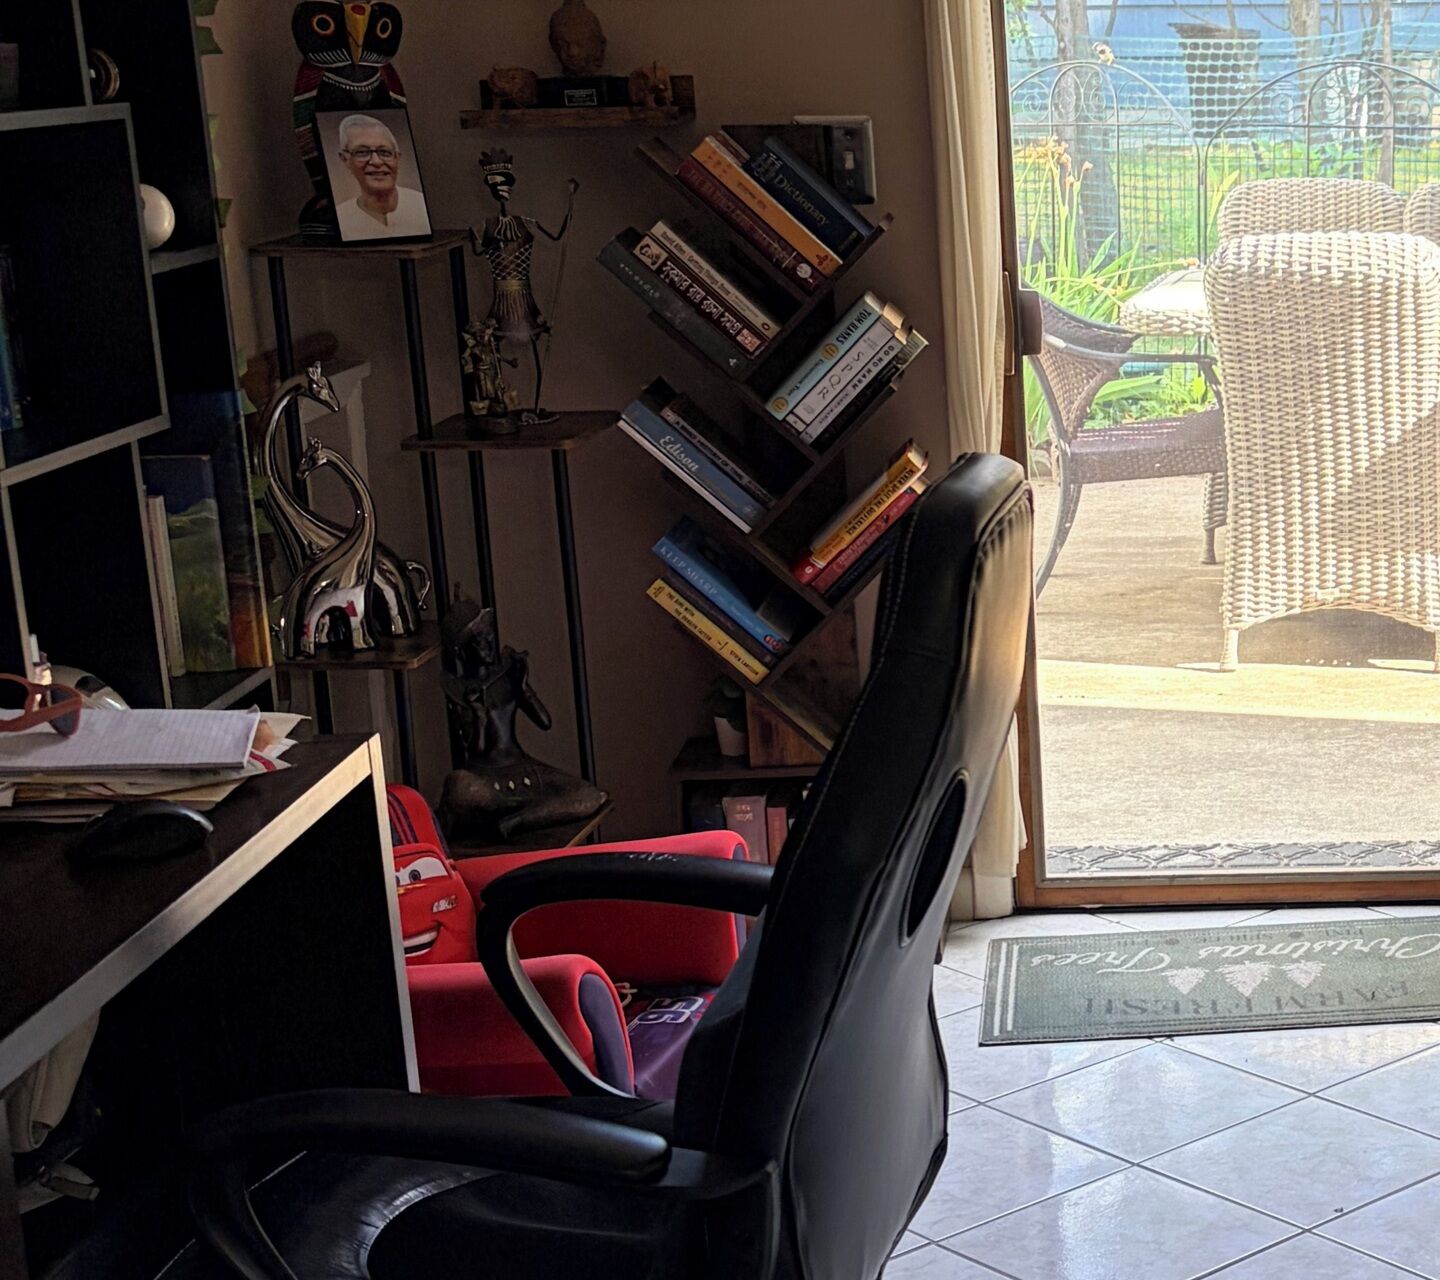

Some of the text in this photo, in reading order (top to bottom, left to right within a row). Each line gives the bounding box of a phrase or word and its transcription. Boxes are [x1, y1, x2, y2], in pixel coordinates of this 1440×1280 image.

[771, 172, 831, 228] Dictionary
[834, 307, 871, 346] TOM HANKS
[850, 367, 872, 391] HARM
[657, 432, 703, 472] Edison
[658, 545, 718, 597] KEEP SHARP
[1030, 947, 1171, 974] Trees
